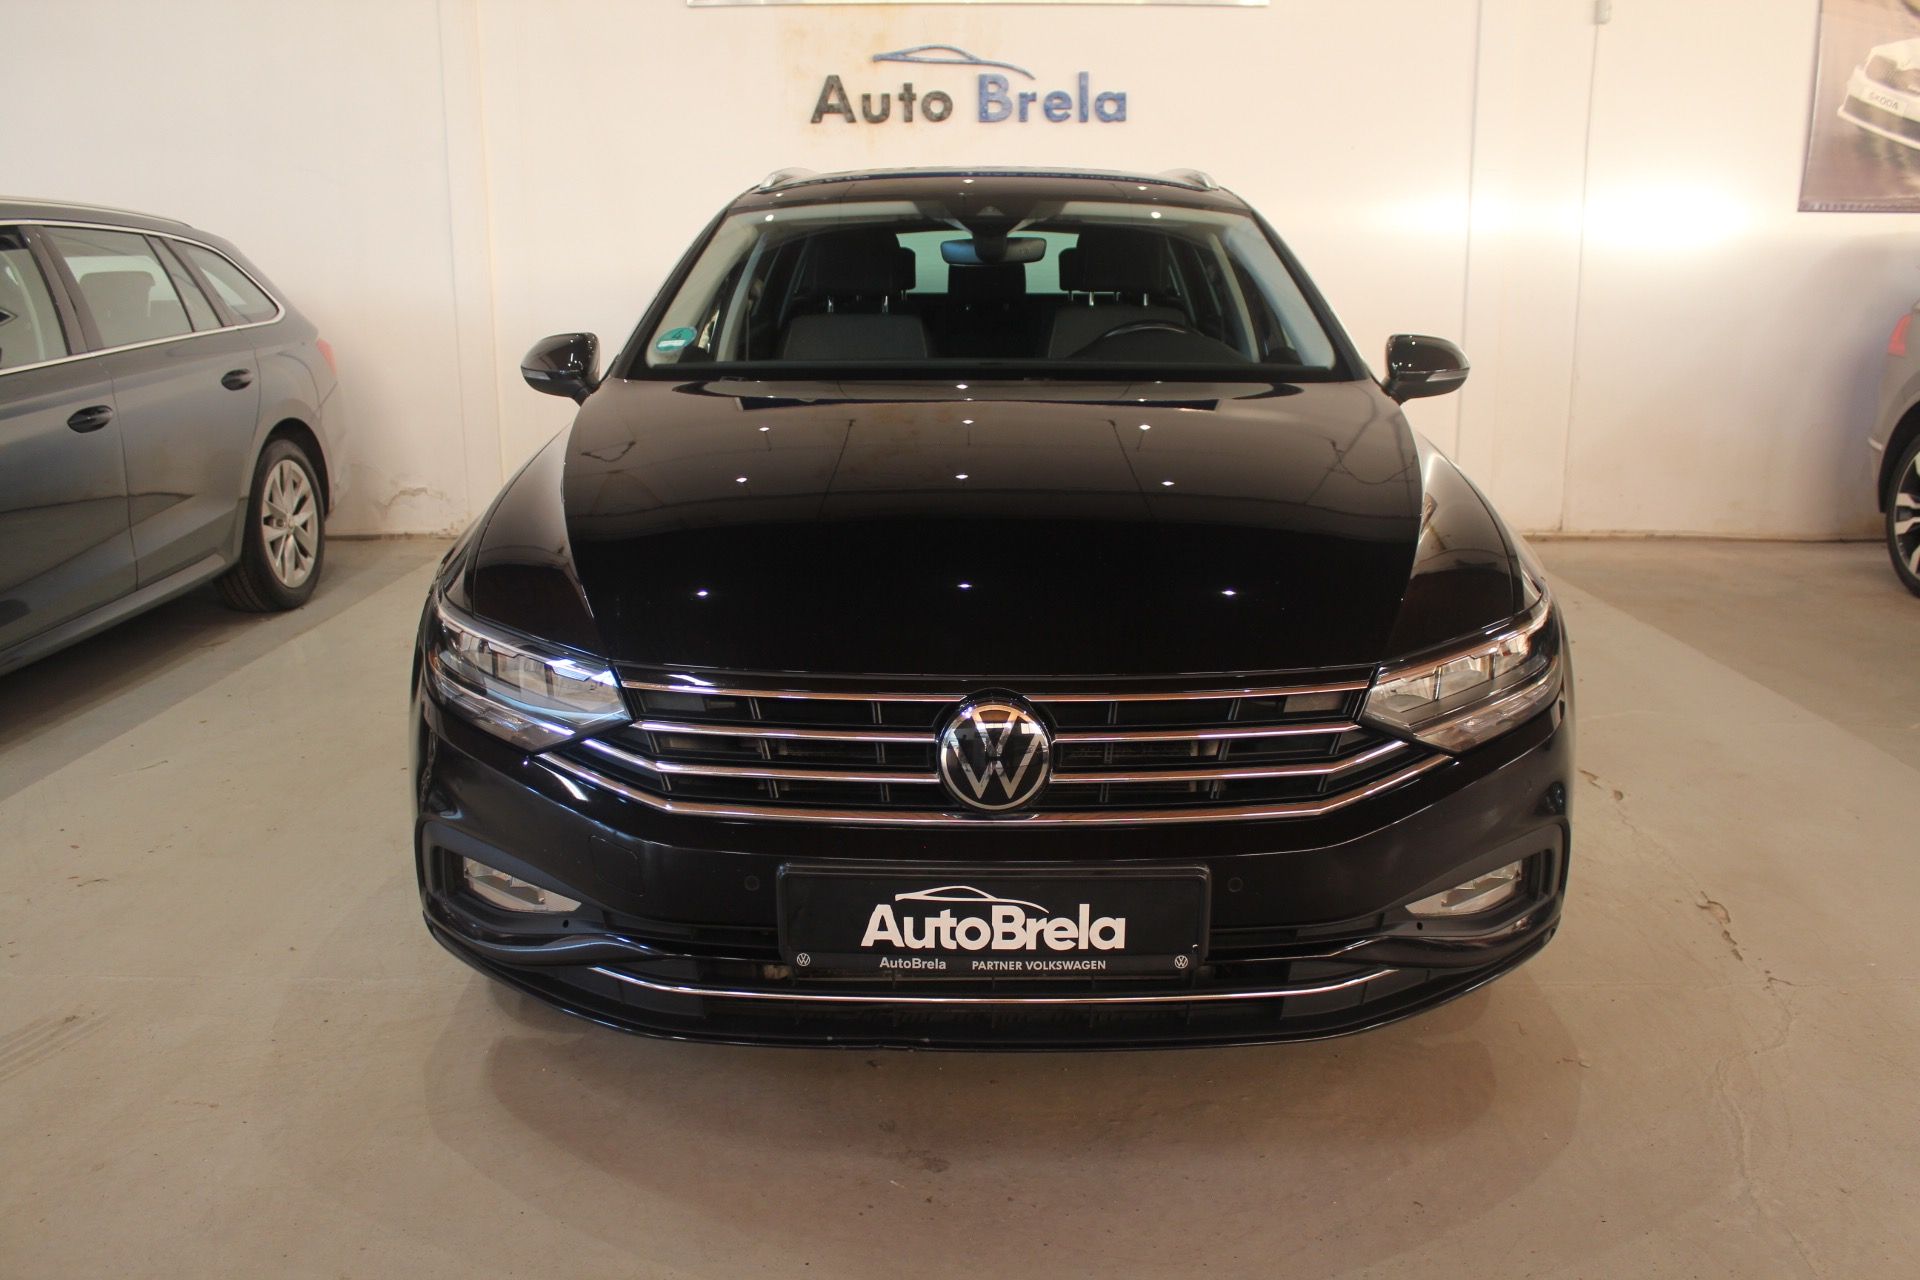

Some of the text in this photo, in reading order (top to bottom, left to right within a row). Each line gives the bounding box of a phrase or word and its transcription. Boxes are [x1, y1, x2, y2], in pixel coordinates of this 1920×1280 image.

[810, 71, 1128, 124] Auto Brela
[860, 903, 1126, 952] AutoBrela
[879, 956, 947, 970] AutoBrela
[971, 960, 1107, 971] PARTNER VOLKSWAGEN
